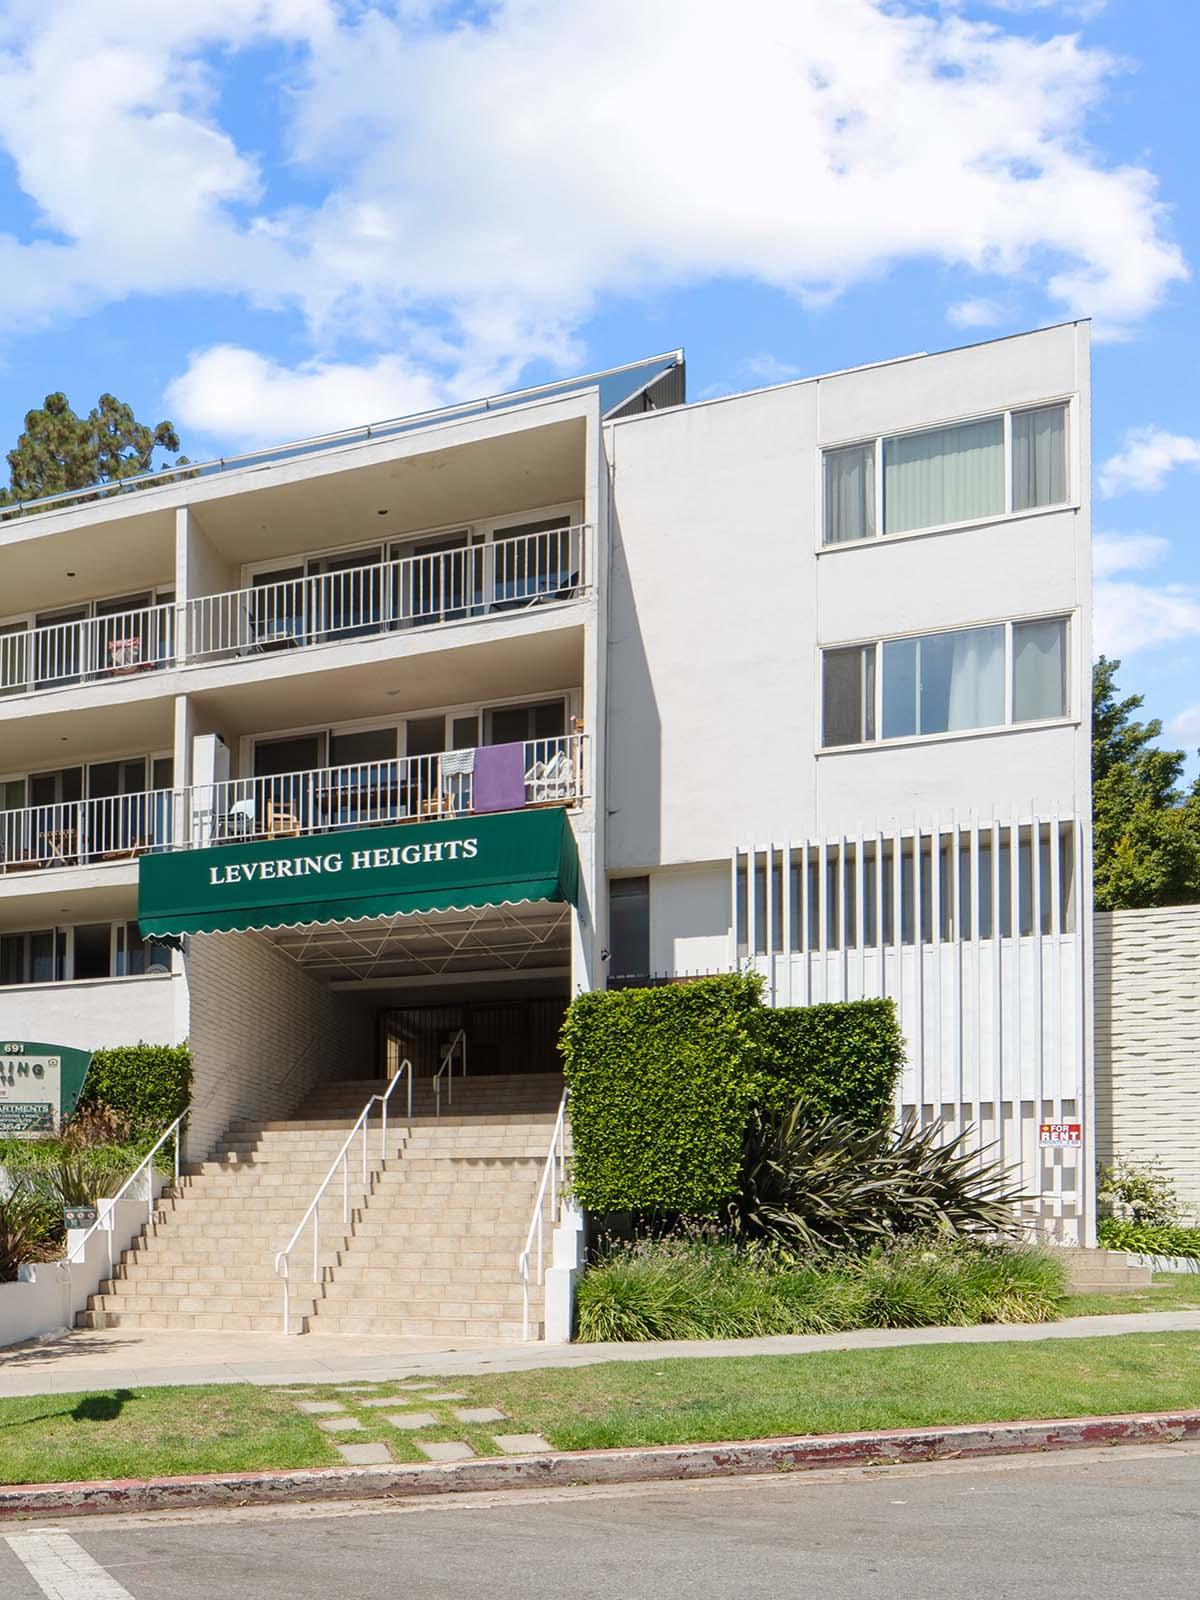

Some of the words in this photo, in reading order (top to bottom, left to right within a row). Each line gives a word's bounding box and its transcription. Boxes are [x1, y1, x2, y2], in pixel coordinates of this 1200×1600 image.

[209, 853, 343, 885] LEVERING
[352, 838, 478, 869] HEIGHTS
[4, 1044, 24, 1053] 691
[1041, 1132, 1078, 1140] RENT
